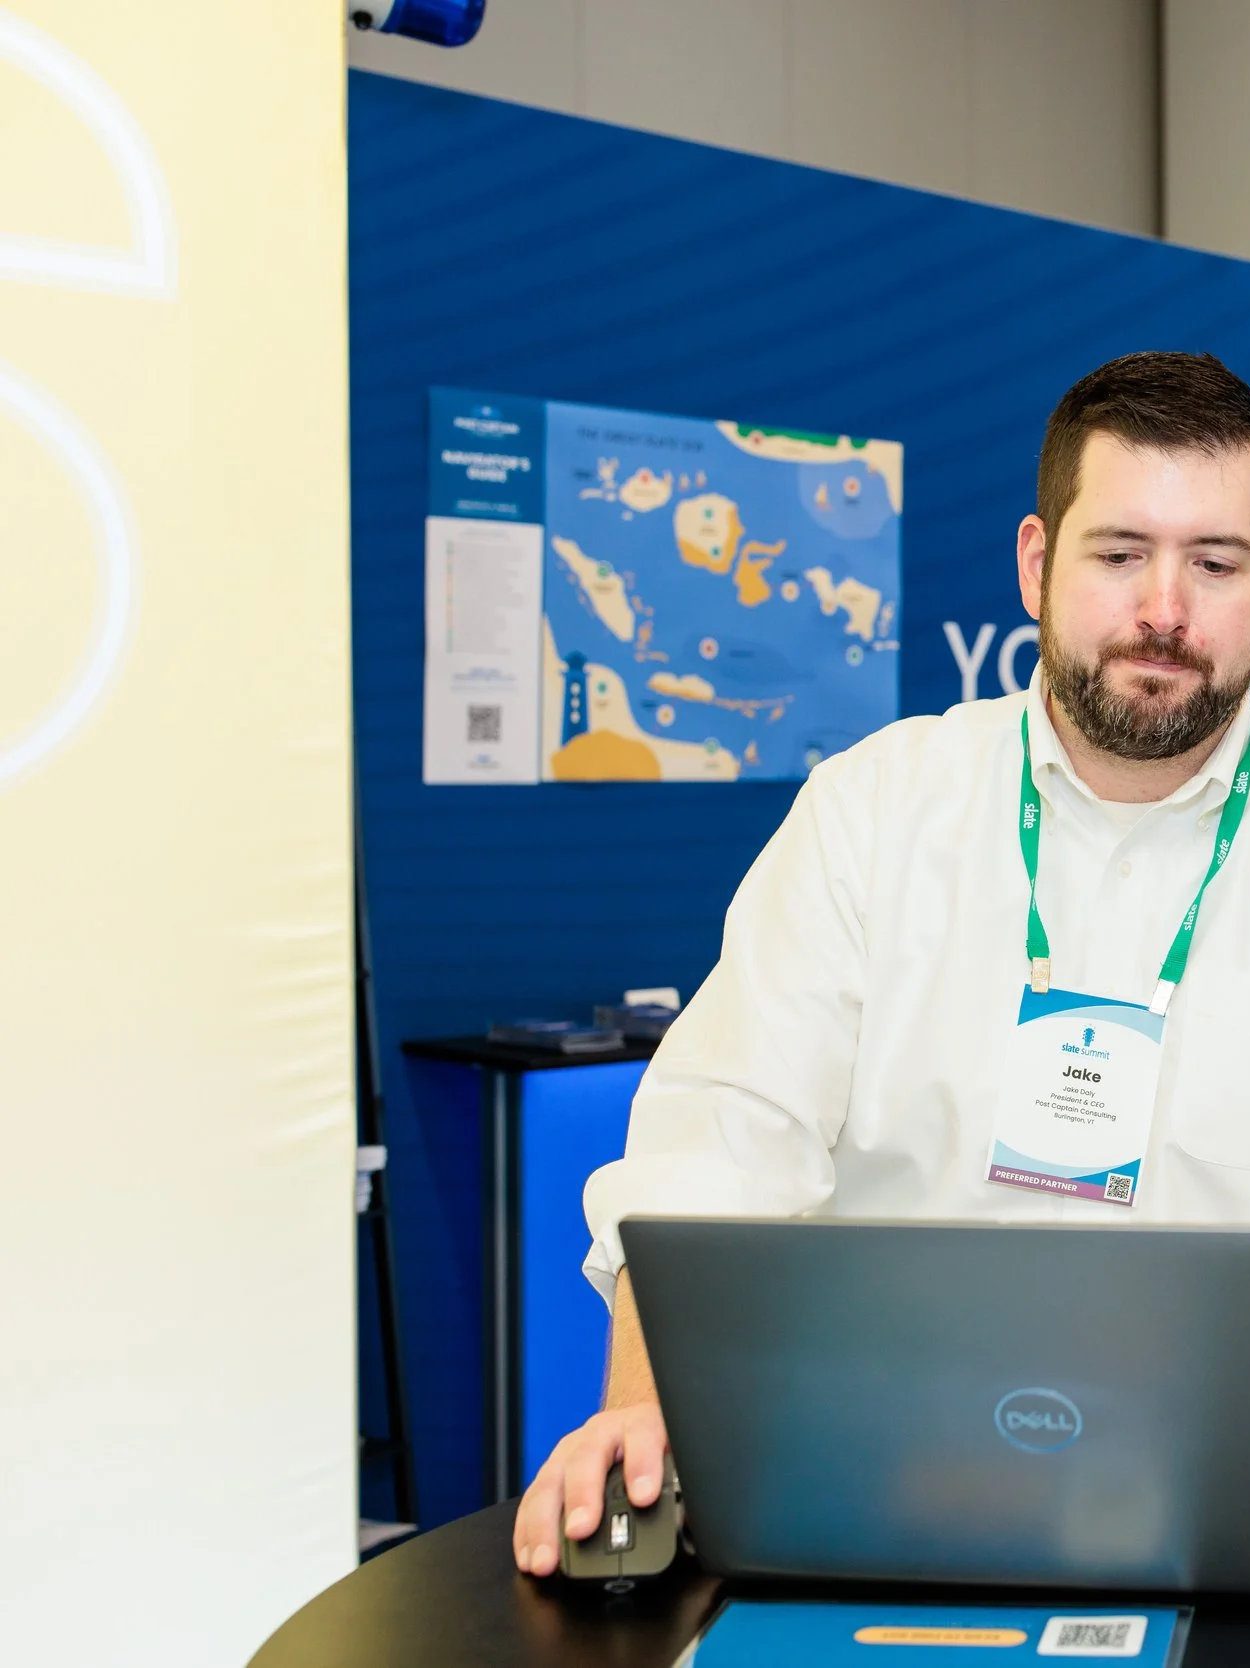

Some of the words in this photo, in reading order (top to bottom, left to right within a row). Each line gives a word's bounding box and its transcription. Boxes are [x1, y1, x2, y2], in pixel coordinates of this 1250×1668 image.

[1232, 771, 1250, 794] slate
[1023, 803, 1039, 829] slate
[1217, 839, 1230, 866] slate
[1184, 903, 1198, 931] slate
[1062, 1042, 1080, 1054] slate
[1081, 1048, 1110, 1060] summit
[1062, 1066, 1102, 1083] Jake
[1050, 1093, 1082, 1105] President
[1051, 1103, 1079, 1113] Captain
[1080, 1108, 1117, 1121] Consulting
[995, 1170, 1040, 1184] PREFERRED
[1040, 1178, 1078, 1192] PARTNER
[1006, 1411, 1074, 1431] DELL
